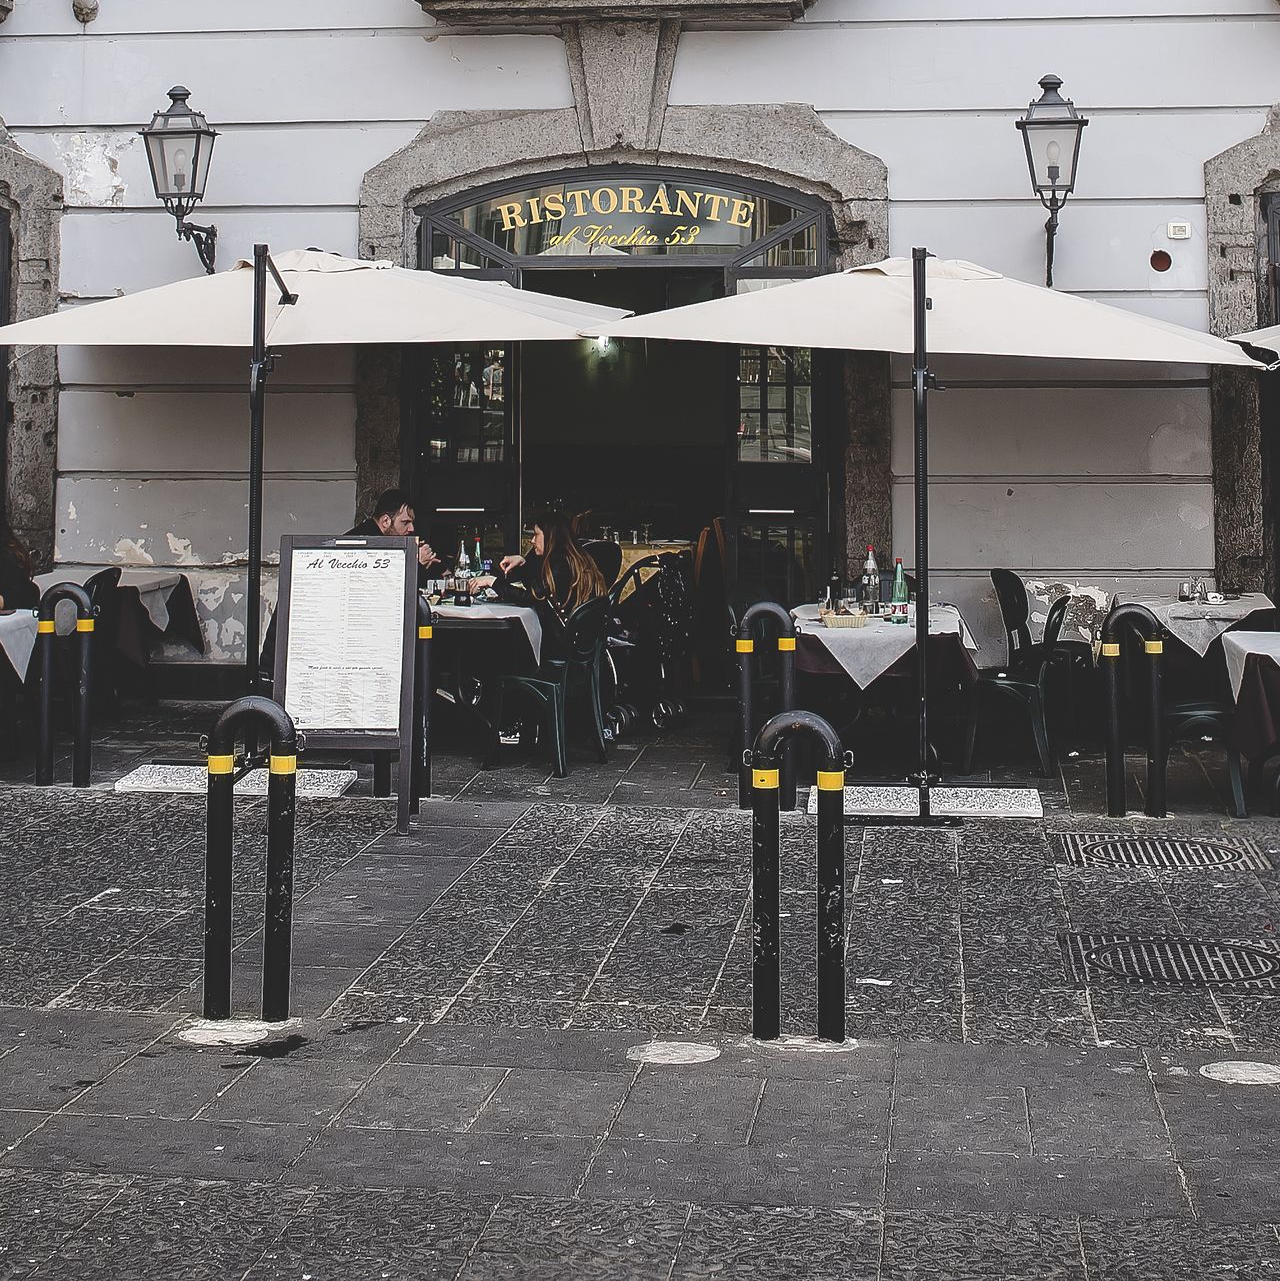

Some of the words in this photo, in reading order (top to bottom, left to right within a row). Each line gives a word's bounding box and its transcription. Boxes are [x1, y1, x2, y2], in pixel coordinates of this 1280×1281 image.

[497, 187, 755, 231] RISTORANTE
[549, 225, 581, 246] al
[582, 224, 659, 247] Vecchio
[664, 225, 700, 246] 53
[306, 558, 324, 570] Al
[328, 558, 368, 569] Vecchio
[373, 559, 391, 569] 53
